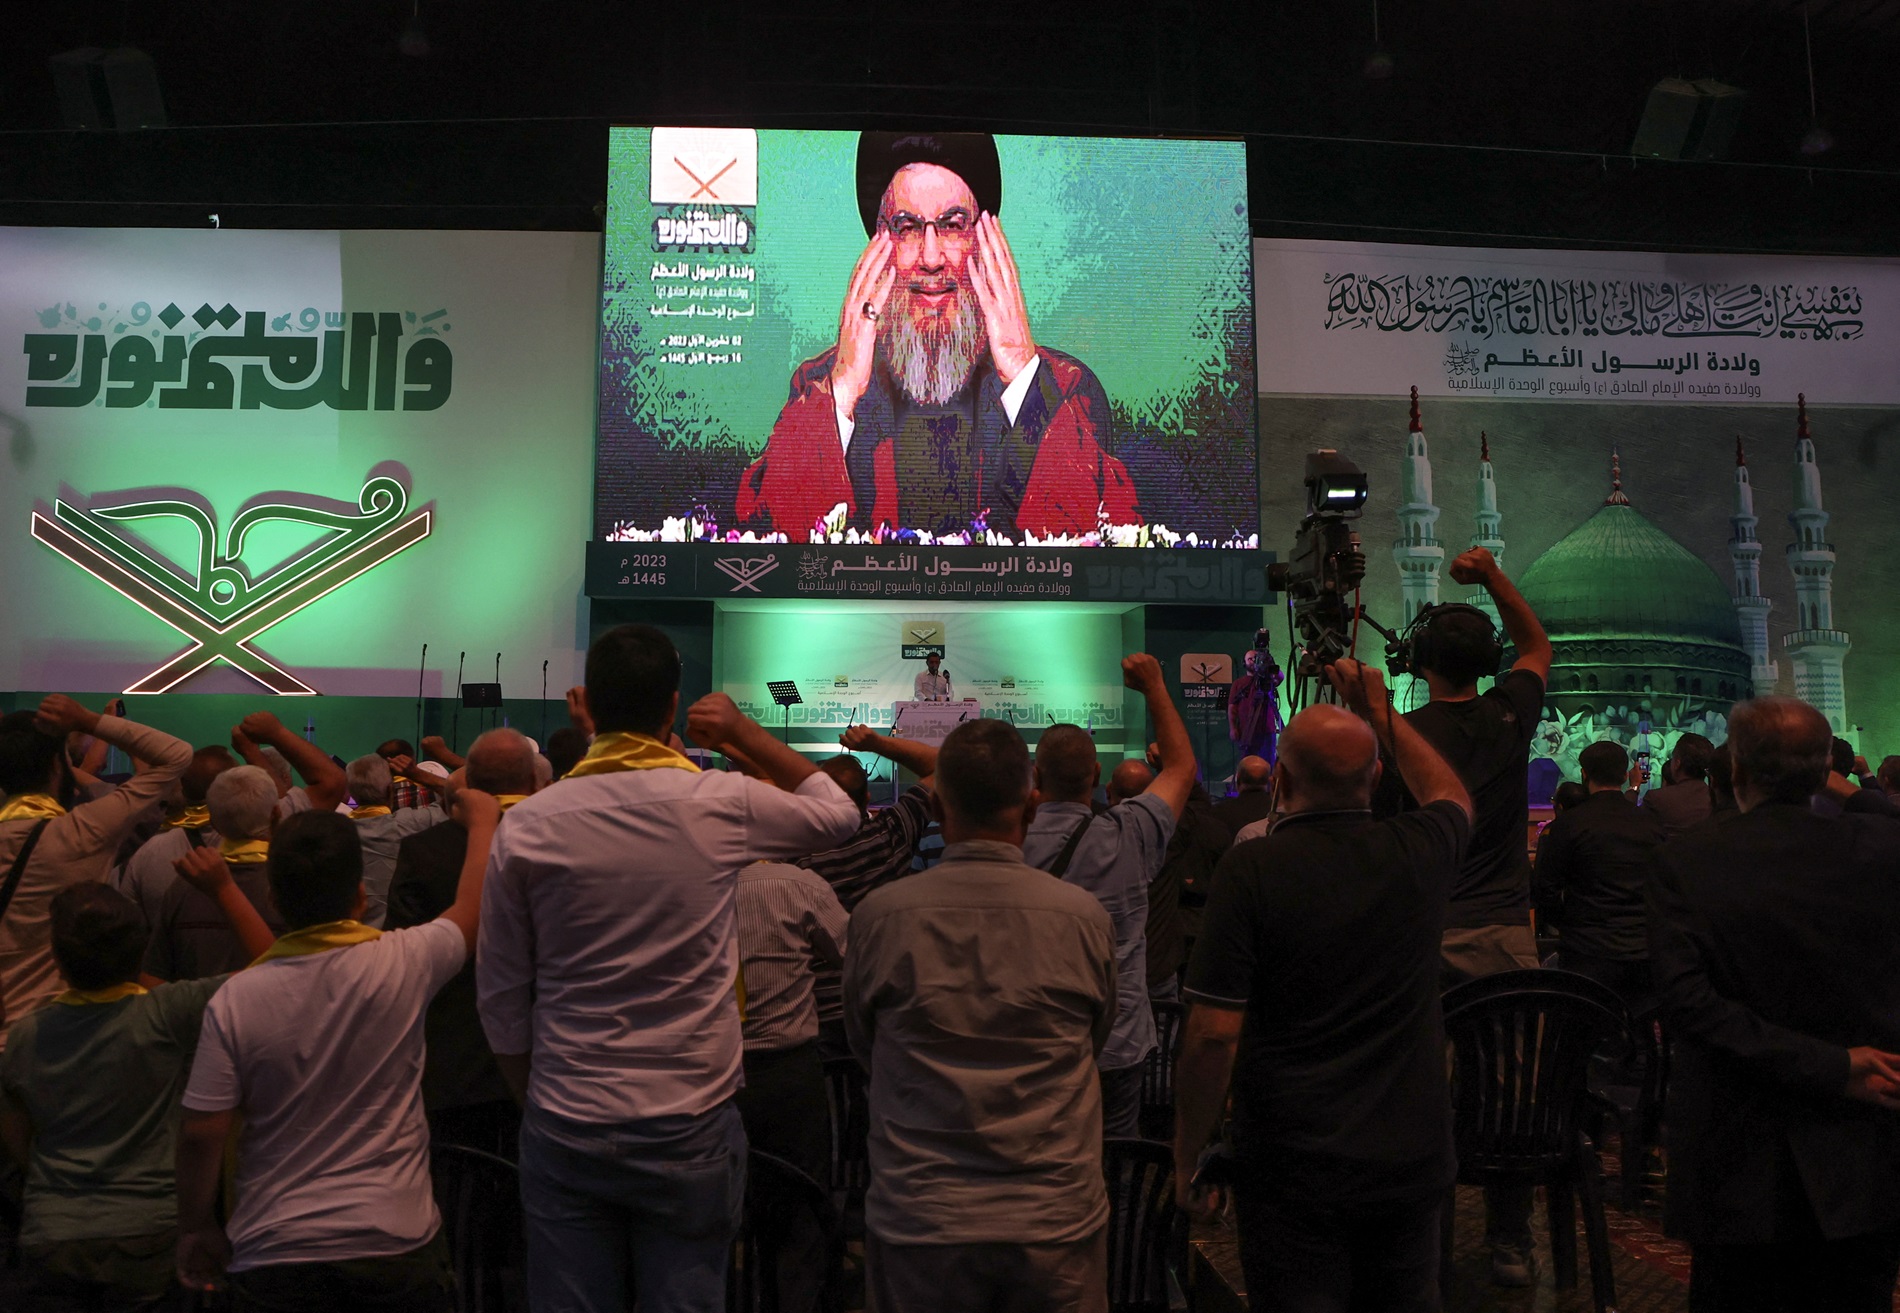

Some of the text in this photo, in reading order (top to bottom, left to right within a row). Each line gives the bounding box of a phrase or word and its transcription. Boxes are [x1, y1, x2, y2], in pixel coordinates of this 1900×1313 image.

[691, 263, 726, 281] الرسول
[729, 263, 754, 282] ولادة
[1484, 346, 1760, 376] ولادة الرسول الأعظم
[1448, 376, 1505, 395] الإسلامية
[1508, 377, 1545, 394] الوحدة
[1549, 375, 1591, 396] وأسبوع
[1610, 379, 1648, 396] الصادق
[1652, 380, 1684, 398] الإمام
[1688, 382, 1720, 397] حفيده
[1725, 382, 1761, 398] وولادة
[620, 554, 667, 569] 2023 م
[831, 552, 1073, 577] ولادة الرسول الأعظم
[632, 572, 666, 585] 1445
[885, 577, 921, 595] وأسبوع
[797, 580, 847, 595] الإسلامية
[850, 580, 881, 594] الوحدة
[938, 581, 971, 595] الصادق
[975, 581, 1003, 596] الإمام
[1007, 582, 1035, 595] حفيده
[1038, 582, 1071, 596] وولادة
